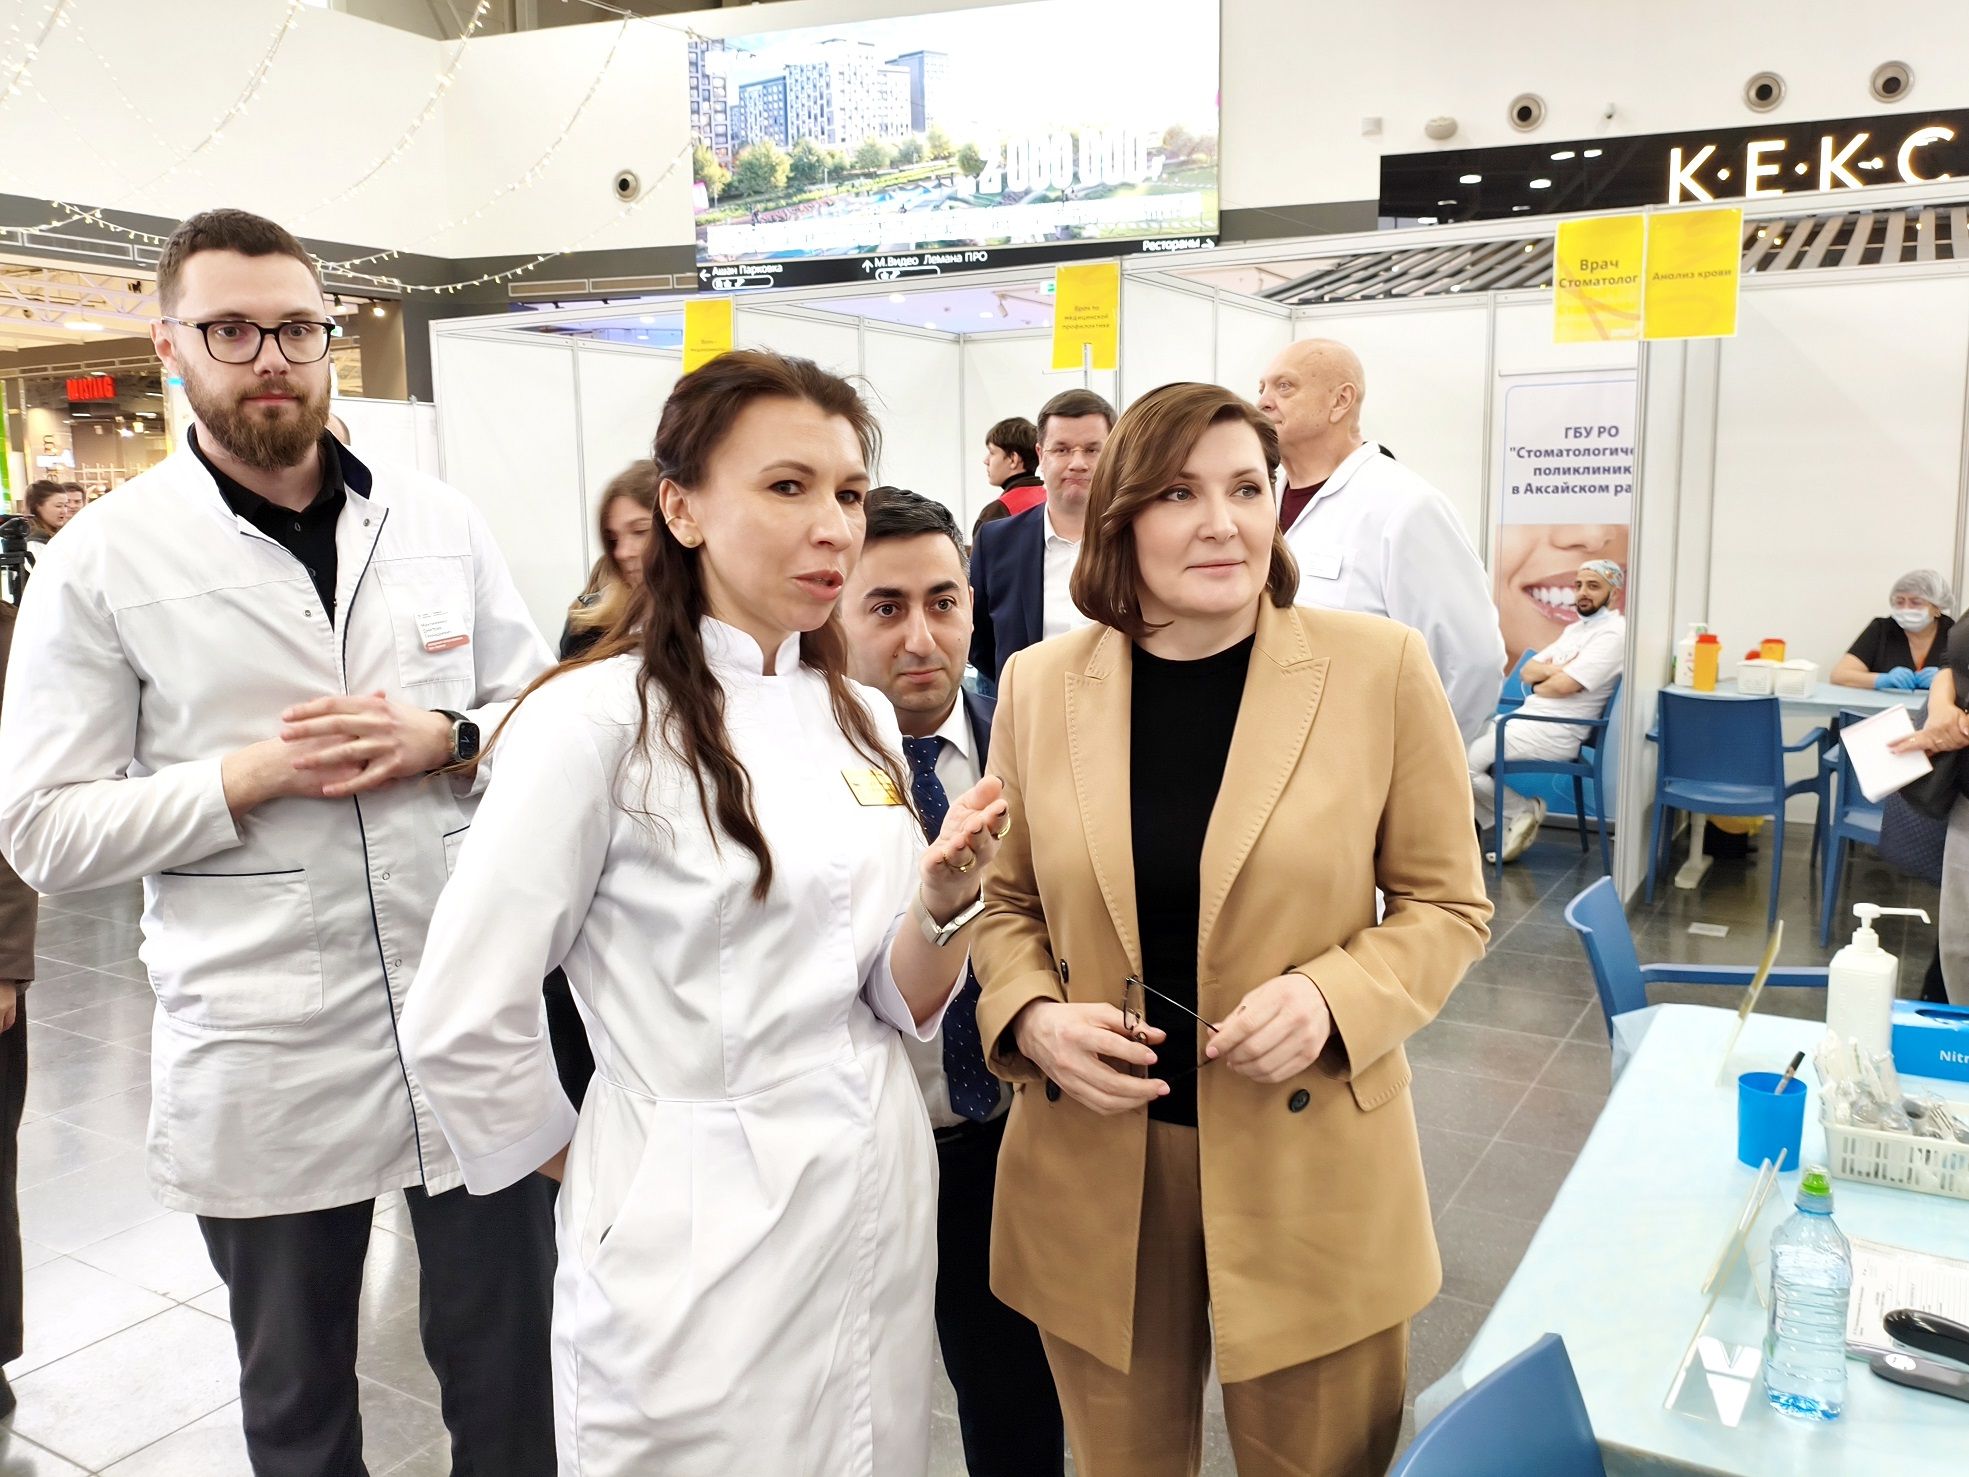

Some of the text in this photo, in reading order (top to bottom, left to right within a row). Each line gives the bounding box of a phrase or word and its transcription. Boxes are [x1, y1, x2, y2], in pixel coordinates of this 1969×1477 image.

[1142, 238, 1201, 253] Рестораны
[874, 251, 988, 268] М.Видео Лемана ПРО
[1580, 258, 1619, 273] Врач
[711, 264, 784, 276] Ашан Парковка
[1652, 268, 1732, 281] Анализ крови
[1558, 274, 1639, 289] Стоматолог
[1564, 425, 1620, 439] ГБУ РО
[1533, 465, 1632, 477] поликлиник
[1511, 485, 1519, 495] в
[1524, 481, 1610, 495] Аксайском
[1939, 1049, 1969, 1064] Nitr
